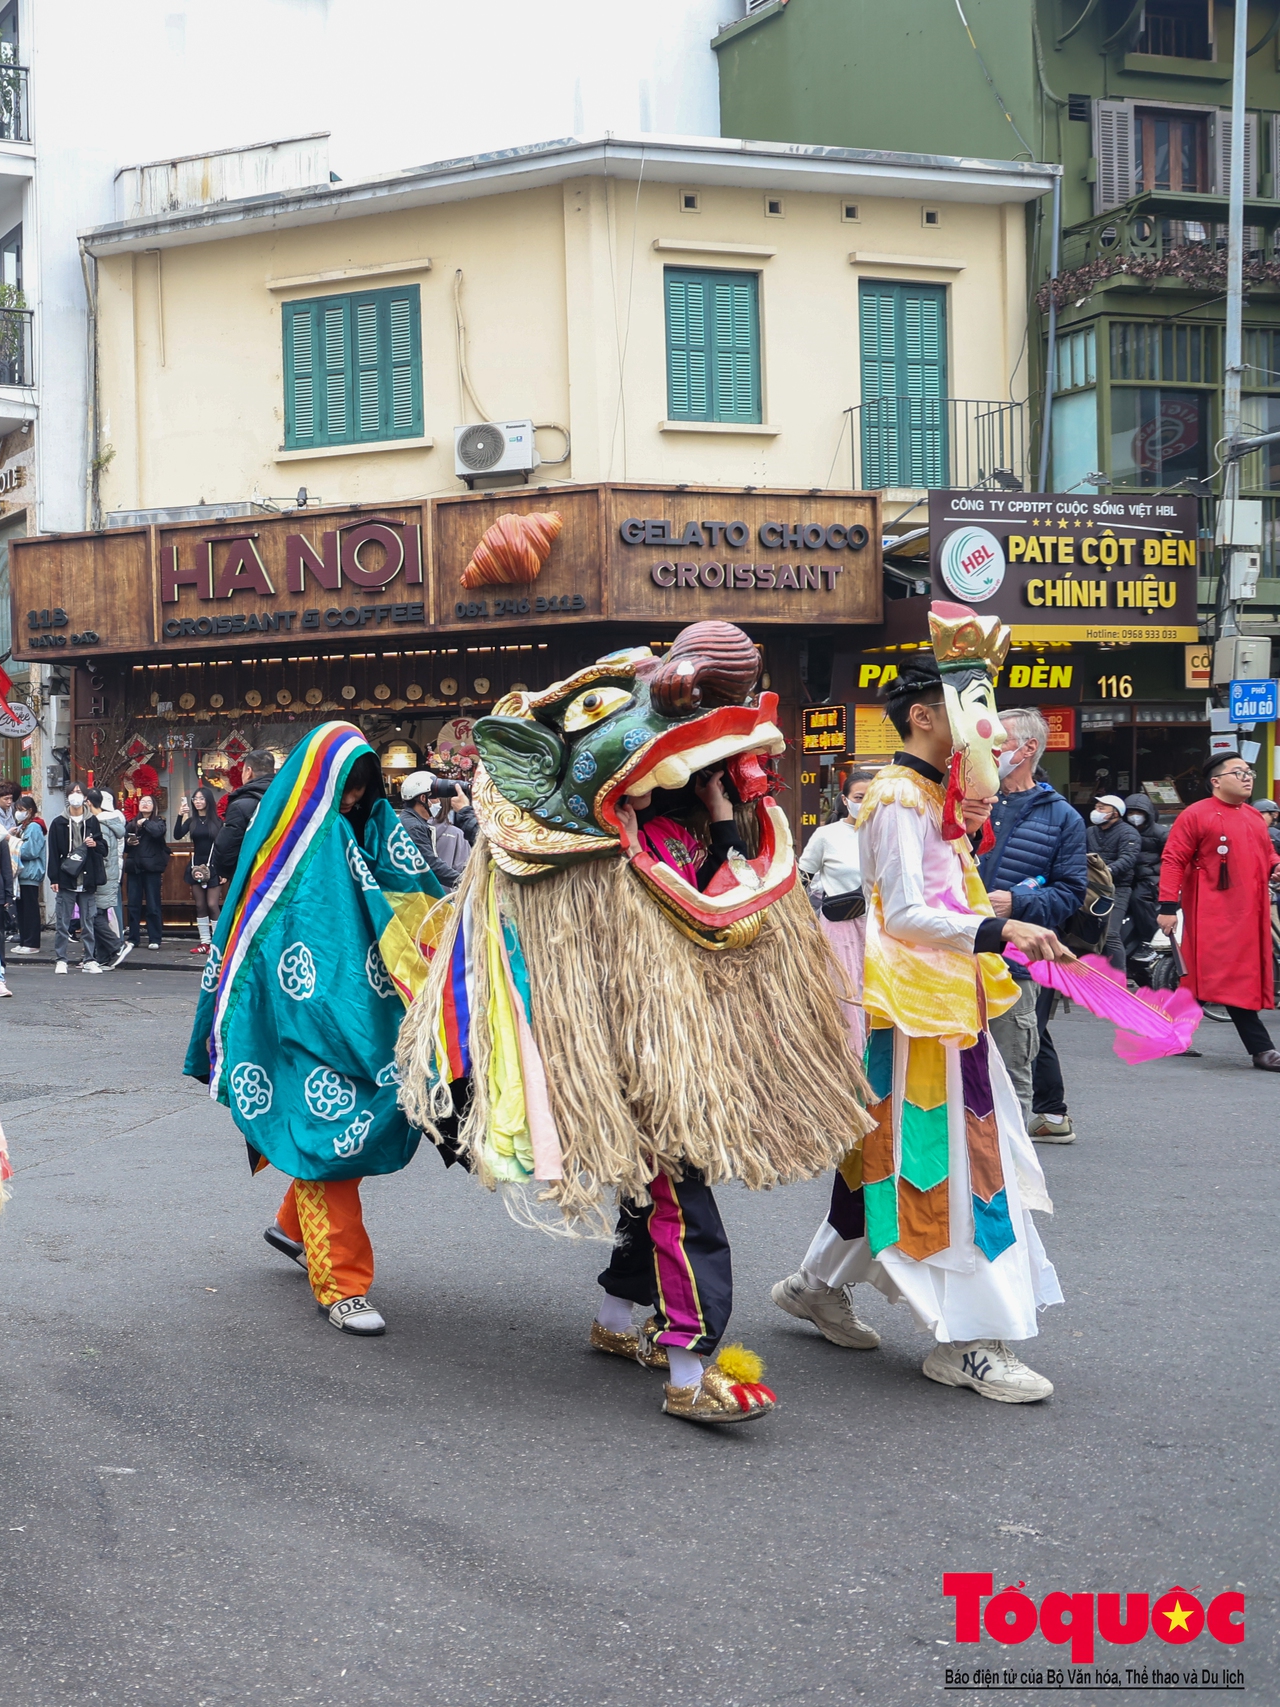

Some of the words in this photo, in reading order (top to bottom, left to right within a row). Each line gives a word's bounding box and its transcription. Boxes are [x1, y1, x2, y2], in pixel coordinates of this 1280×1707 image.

[951, 496, 984, 511] CÔNG
[989, 500, 1005, 512] TY
[1007, 501, 1053, 513] CPĐTPT
[1055, 500, 1088, 517] CUỘC
[1093, 500, 1125, 515] SỐNG
[1128, 502, 1152, 518] VIỆT
[1155, 505, 1178, 516] HBL
[620, 517, 750, 547] GELATO
[760, 521, 870, 550] CHOCO
[286, 516, 423, 593] NỘI
[960, 544, 995, 575] HBL
[1009, 535, 1074, 563] PATE
[1081, 528, 1136, 572] CỘT
[1143, 531, 1196, 566] ĐÈN
[651, 560, 844, 591] CROISSANT
[454, 600, 489, 618] 081
[493, 597, 530, 616] 246
[1026, 572, 1108, 607] CHÍNH
[1116, 573, 1177, 615] HIỆU
[161, 609, 297, 638] CROISSANT
[301, 608, 320, 628] &
[323, 601, 425, 628] COFFEE
[1086, 629, 1120, 639] Hotline:
[1122, 630, 1143, 639] 0968
[1145, 630, 1160, 639] 933
[1162, 630, 1177, 639] 033
[1009, 658, 1073, 689] ĐÈN
[1191, 653, 1211, 670] CỘ
[1097, 674, 1133, 699] 116
[1251, 684, 1266, 694] PHỐ
[1235, 697, 1257, 716] CẦU
[1258, 694, 1273, 714] GỖ
[801, 811, 817, 825] ÈN
